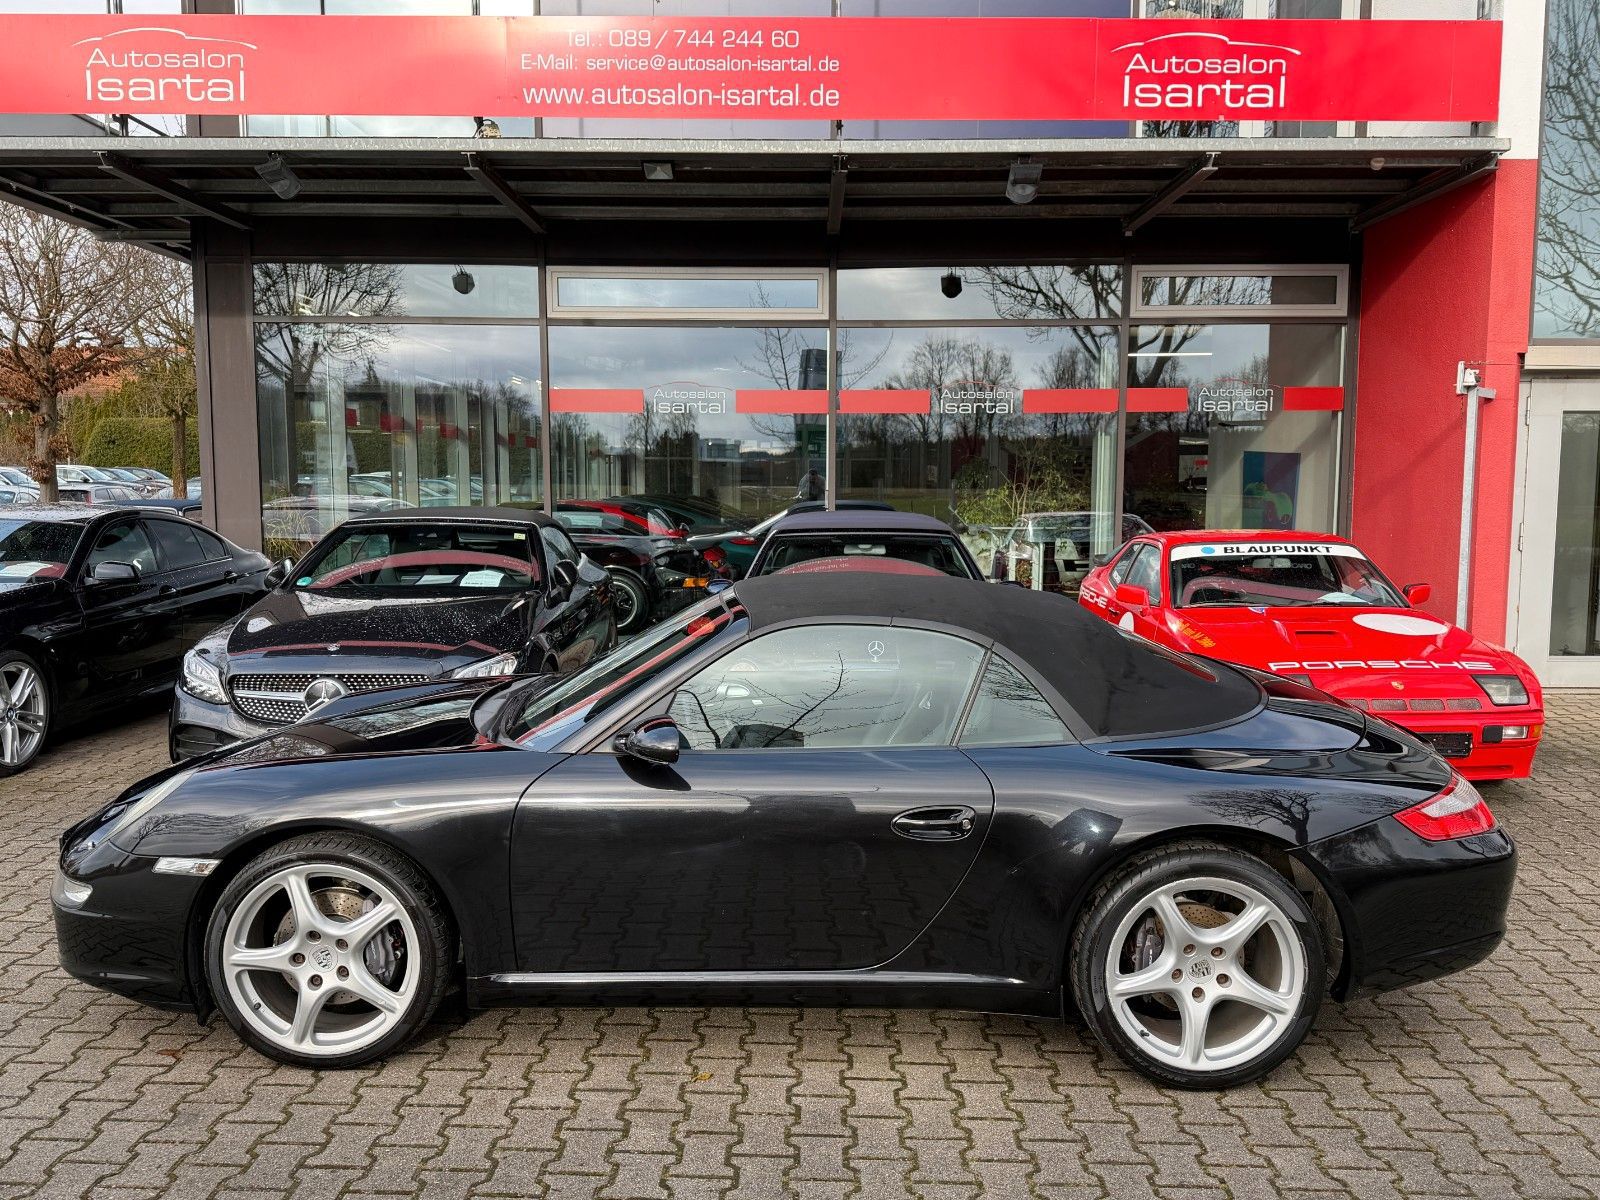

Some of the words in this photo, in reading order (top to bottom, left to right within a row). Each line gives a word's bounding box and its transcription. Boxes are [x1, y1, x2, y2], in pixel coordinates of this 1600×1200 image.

[608, 29, 651, 47] 089
[654, 29, 669, 50] /
[674, 29, 715, 47] 744
[722, 29, 764, 48] 244
[771, 30, 800, 48] 60
[87, 47, 244, 69] Autosalon
[521, 53, 578, 70] E-Mail:
[586, 54, 840, 72] service@autosalon-isartal.de
[1125, 52, 1287, 75] Autosalon
[86, 69, 245, 102] Isartal
[1123, 75, 1287, 108] Isartal
[522, 83, 840, 107] www.autosalon-isartal.de
[654, 388, 726, 399] Autosalon
[941, 389, 1014, 399] Autosalon
[1199, 387, 1274, 397] Autosalon
[653, 399, 726, 414] Isartal
[940, 399, 1014, 414] Isartal
[1197, 397, 1273, 412] Isartal
[1223, 545, 1333, 554] BLAUPUNKT
[1267, 660, 1497, 672] PORSCHE
